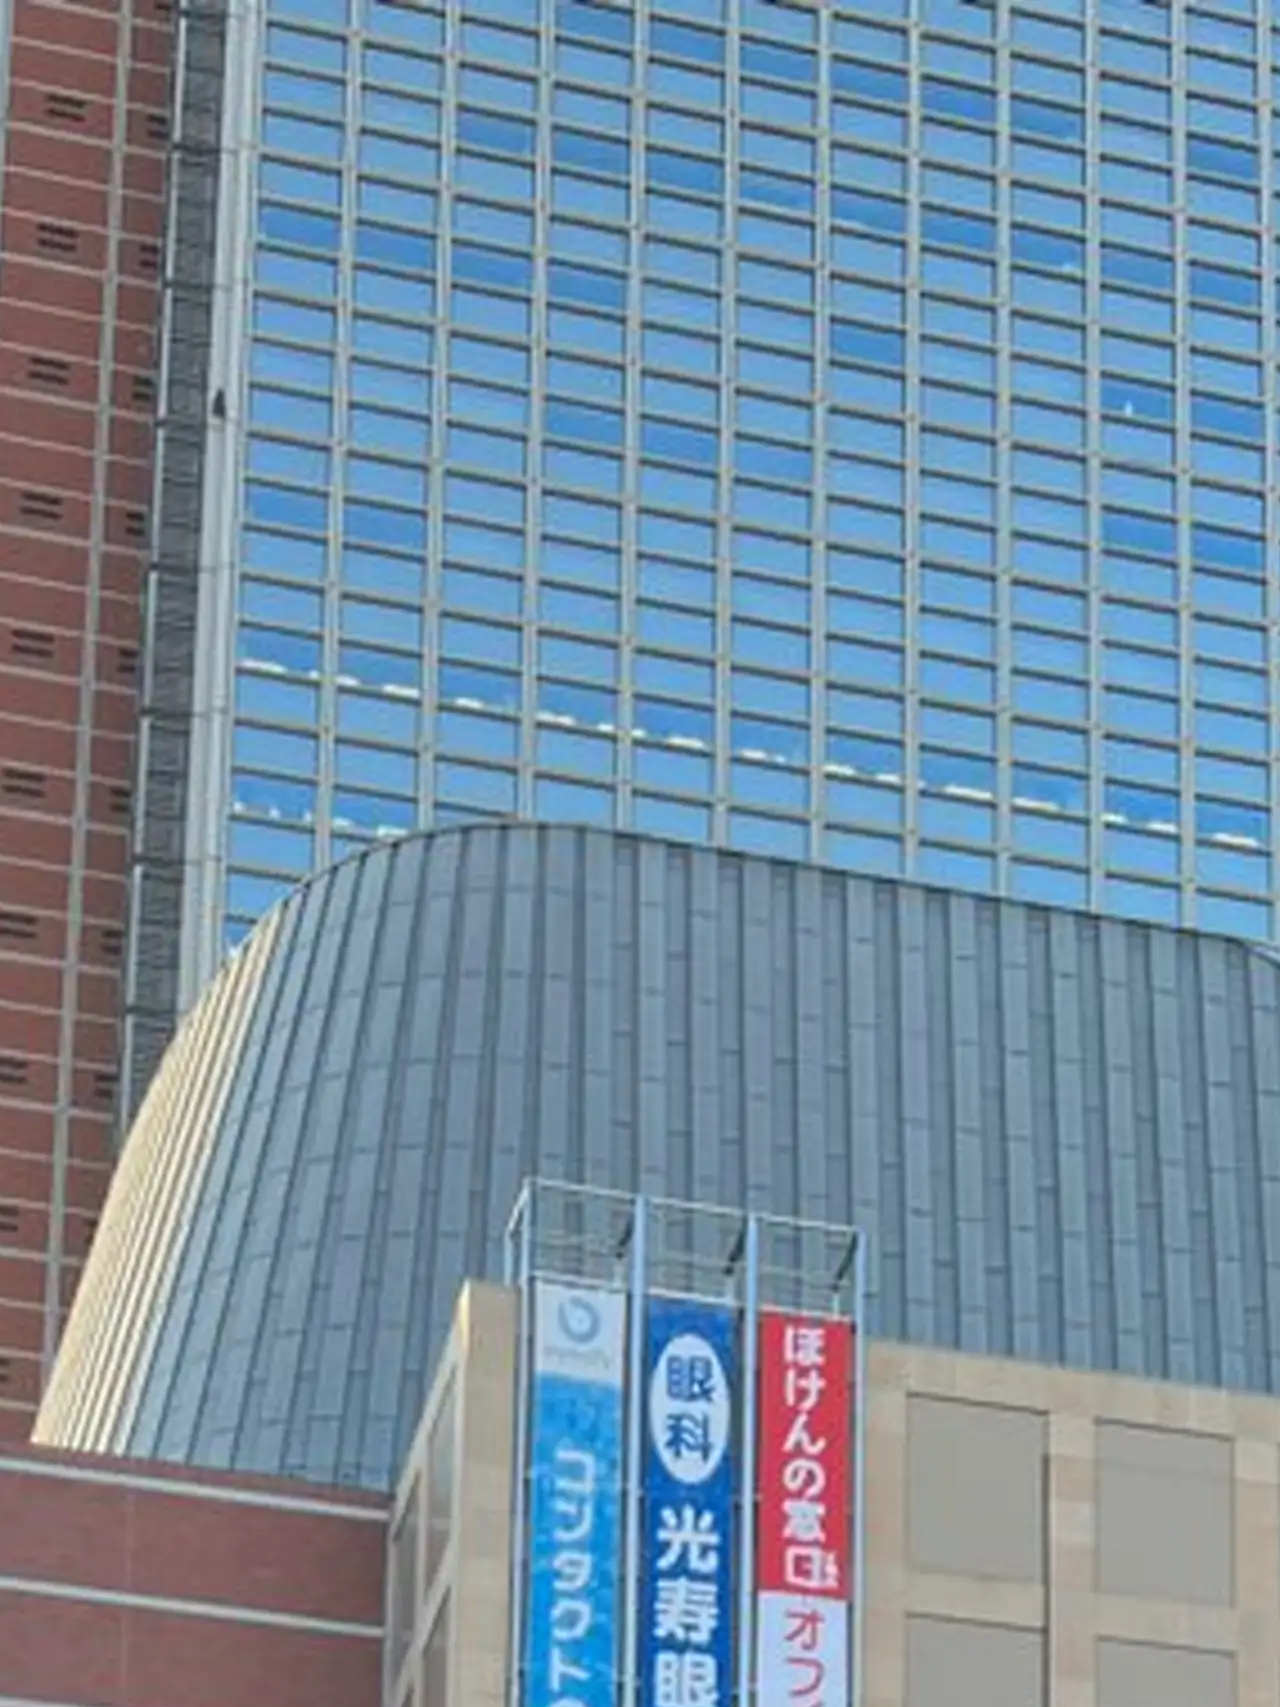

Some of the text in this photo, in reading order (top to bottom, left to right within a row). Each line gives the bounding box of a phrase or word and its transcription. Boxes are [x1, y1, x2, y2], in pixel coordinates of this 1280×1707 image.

[665, 1354, 716, 1463] 眼科
[783, 1324, 826, 1588] ほけんの窓口
